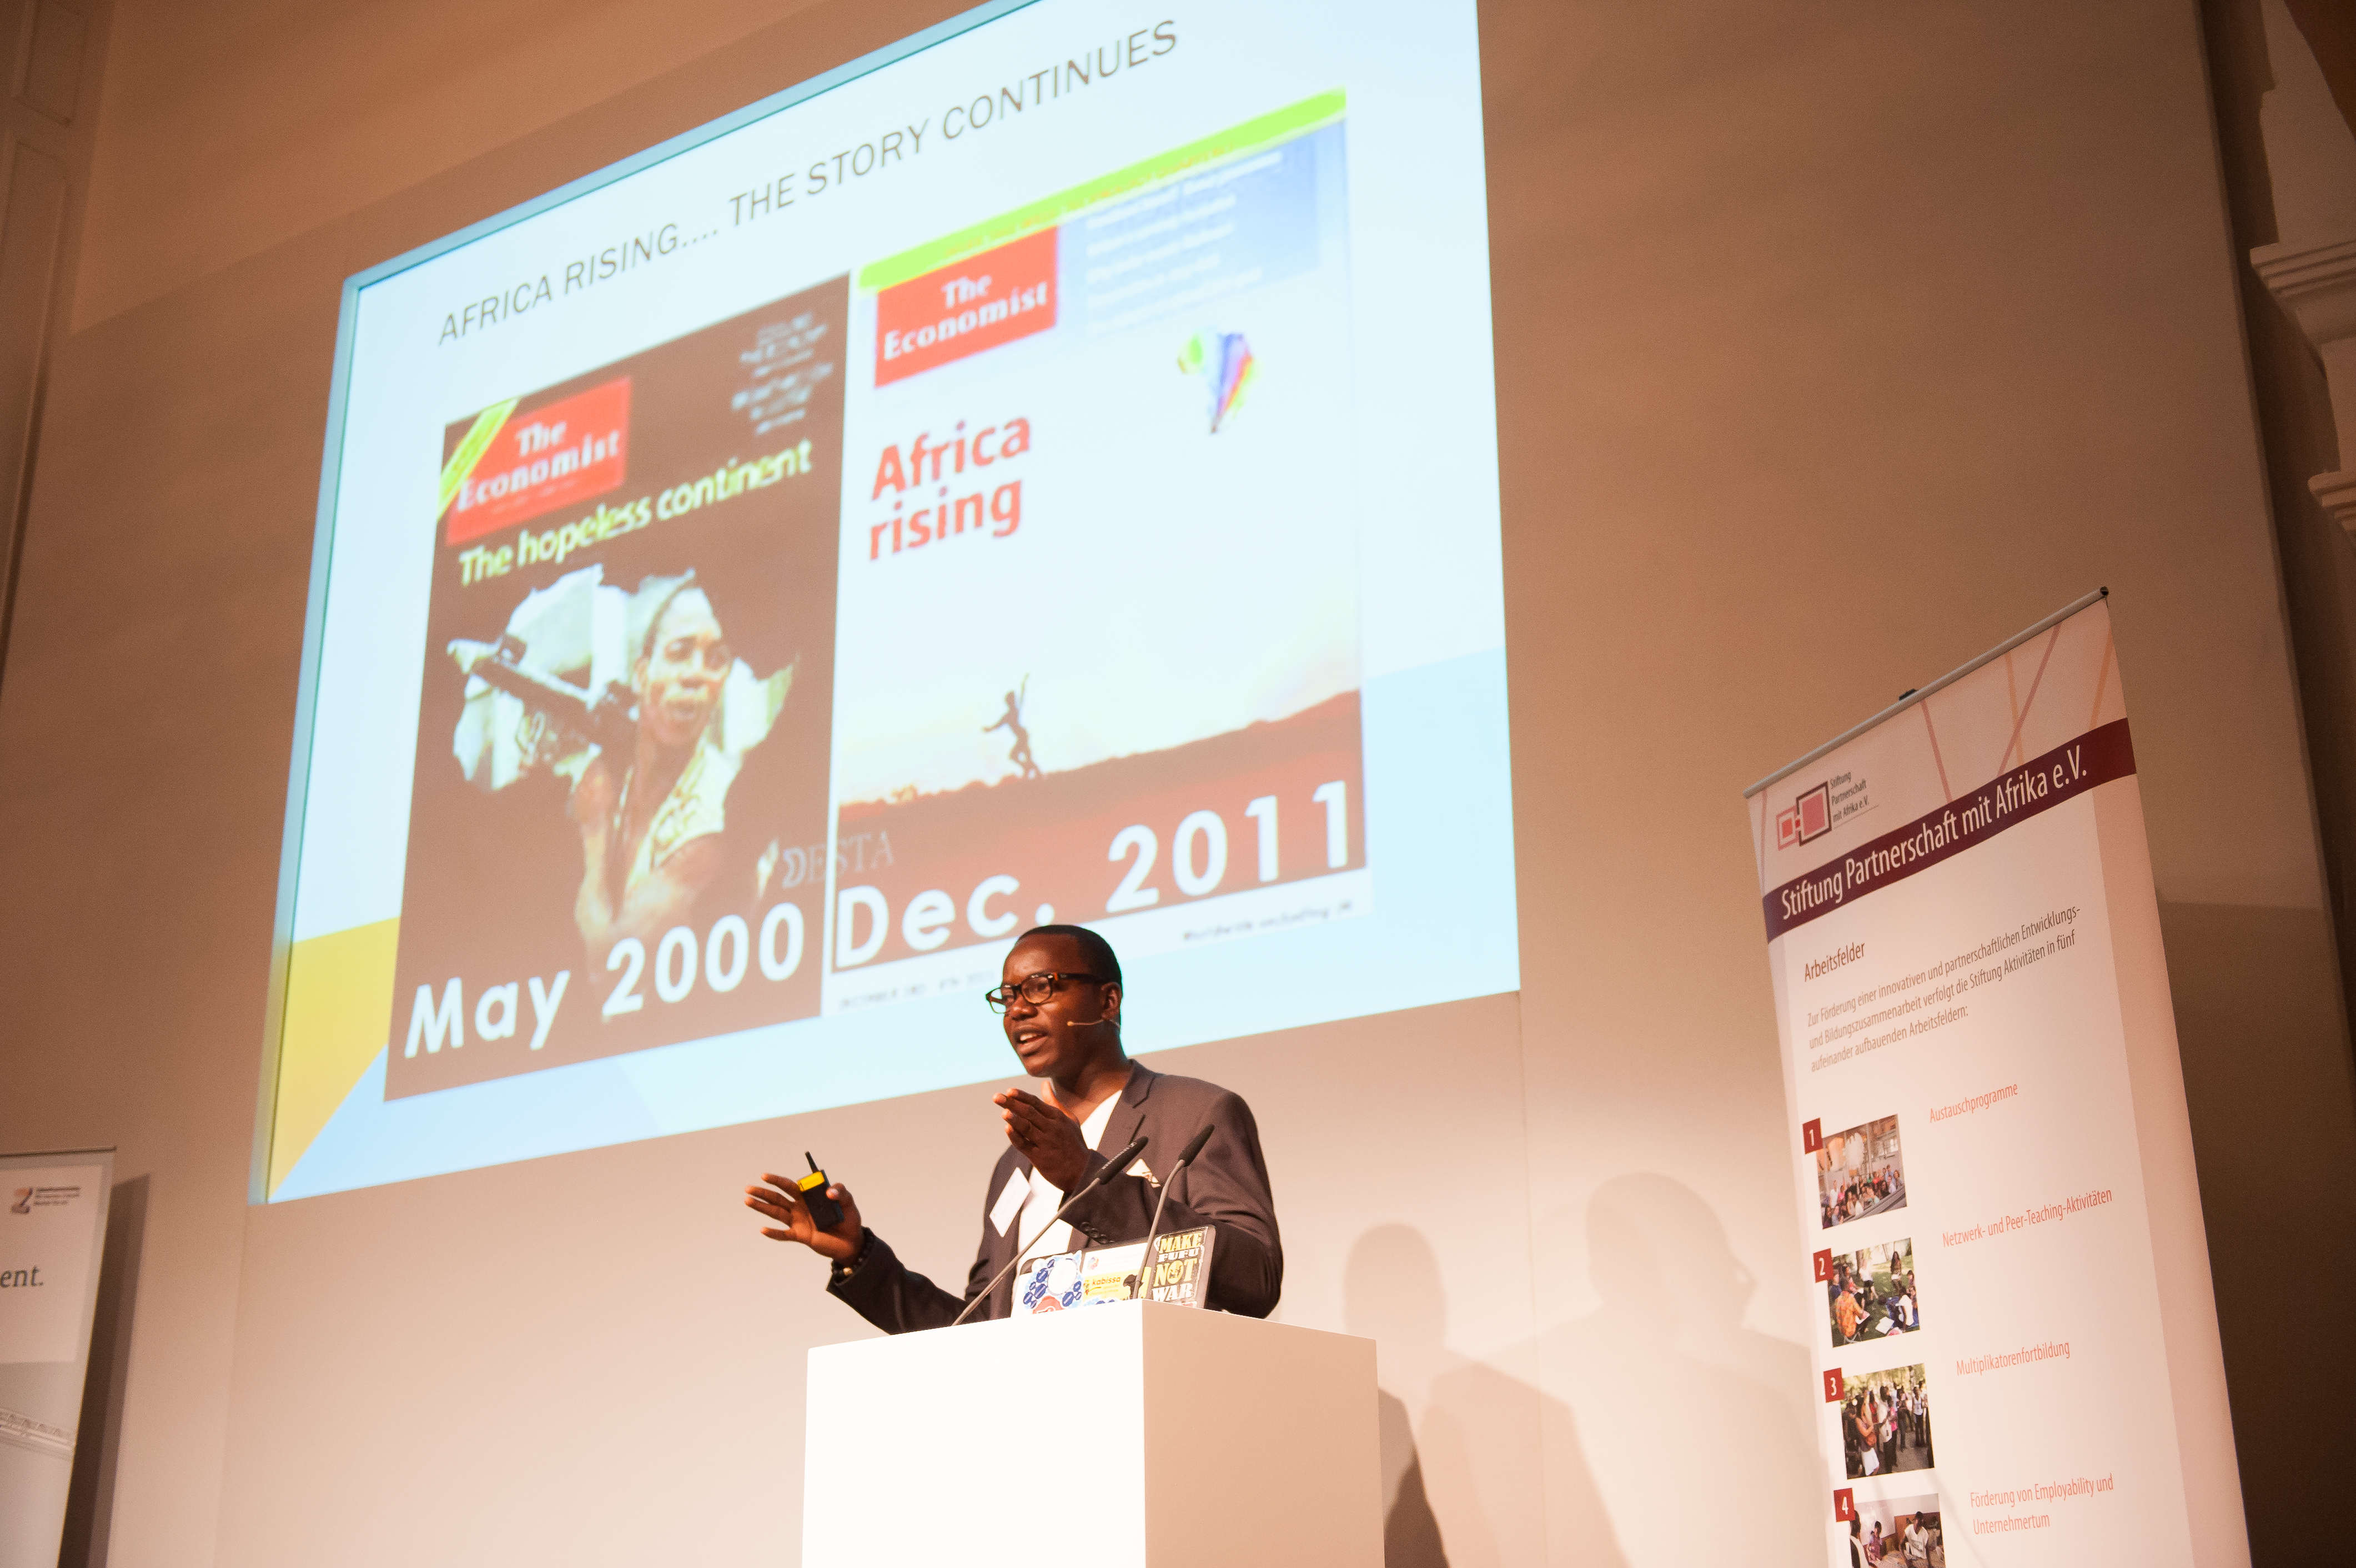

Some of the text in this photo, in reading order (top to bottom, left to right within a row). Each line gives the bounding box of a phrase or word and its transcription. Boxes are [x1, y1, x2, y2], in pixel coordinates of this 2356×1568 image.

[439, 275, 552, 346] AFRICA
[729, 173, 795, 226] THE
[807, 118, 930, 195] STORY
[943, 20, 1177, 140] CONTINUES
[942, 275, 992, 310] The
[883, 282, 1048, 360] Economist
[516, 421, 566, 457] The
[456, 431, 620, 512] Economist
[872, 416, 1030, 501] Africa
[459, 545, 514, 586] The
[518, 496, 652, 567] hopeless
[656, 438, 812, 521] continent
[870, 479, 1022, 561] rising
[1830, 772, 1851, 789] Stiftung
[1831, 778, 1866, 806] Partnerschaft
[1833, 811, 1842, 823] mit
[1843, 803, 1858, 817] Afrika
[1781, 745, 2087, 921] Stiftung Partnerschaft mit Afrika e.V.
[835, 780, 1348, 969] Dec. 2011
[1805, 942, 1865, 982] Arbeitsfelder
[1807, 906, 2081, 1027] Zur Förderung einer innovativen und partnerschaftlichen Entwicklungs-
[404, 902, 805, 1059] May 2000
[1809, 928, 2075, 1049] und Bildungszusammenarbeit verfolgt die Stiftung Aktivitäten in fünf
[1811, 1006, 1968, 1072] aufeinander aufbauenden Arbeitsfeldern:
[1930, 1083, 2018, 1123] Austauschprogramme
[1809, 1128, 1815, 1147] 1
[1942, 1189, 2113, 1248] Netzwerk- und Peer-Teaching-Aktivitäten
[1158, 1232, 1203, 1254] MAKE
[1158, 1247, 1200, 1263] FUFU
[1092, 1276, 1121, 1286] kabissa
[1153, 1258, 1198, 1287] NOT
[1819, 1257, 1826, 1277] 2
[1152, 1283, 1193, 1302] WAR
[1956, 1341, 2071, 1376] Multiplikatorenfortbildung
[1830, 1376, 1837, 1396] 3
[1841, 1496, 1849, 1516] 4
[1970, 1473, 2114, 1509] Förderung von Employability und
[1973, 1514, 2050, 1536] Unternehmertum
